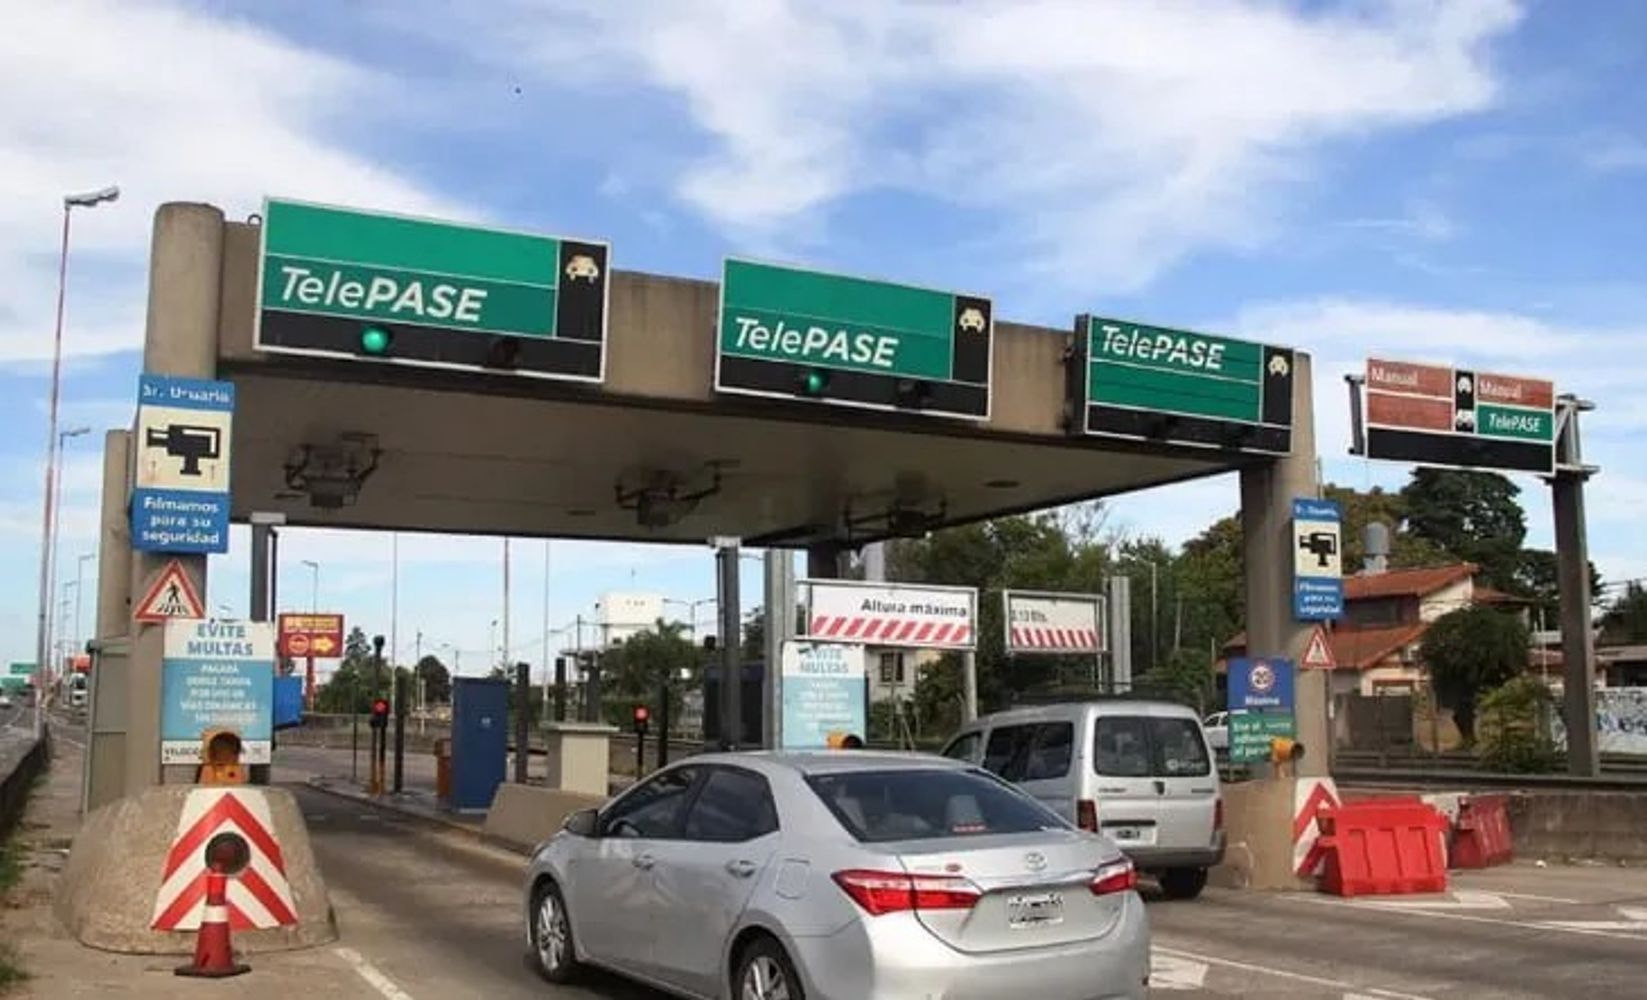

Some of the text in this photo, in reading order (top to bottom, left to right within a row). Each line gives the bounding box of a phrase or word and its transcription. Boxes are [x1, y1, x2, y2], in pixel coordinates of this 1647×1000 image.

[280, 265, 489, 323] TelePASE
[735, 316, 899, 368] TelePASE
[1101, 325, 1226, 370] TelePASE
[1370, 366, 1418, 386] Manual
[1479, 380, 1523, 399] Manual
[1488, 412, 1542, 433] TelePASE
[143, 496, 220, 513] Filmamos
[150, 515, 187, 529] para
[143, 529, 219, 545] seguridad
[861, 598, 906, 613] Altura
[197, 622, 245, 638] EVITE
[187, 640, 254, 656] MULTAS
